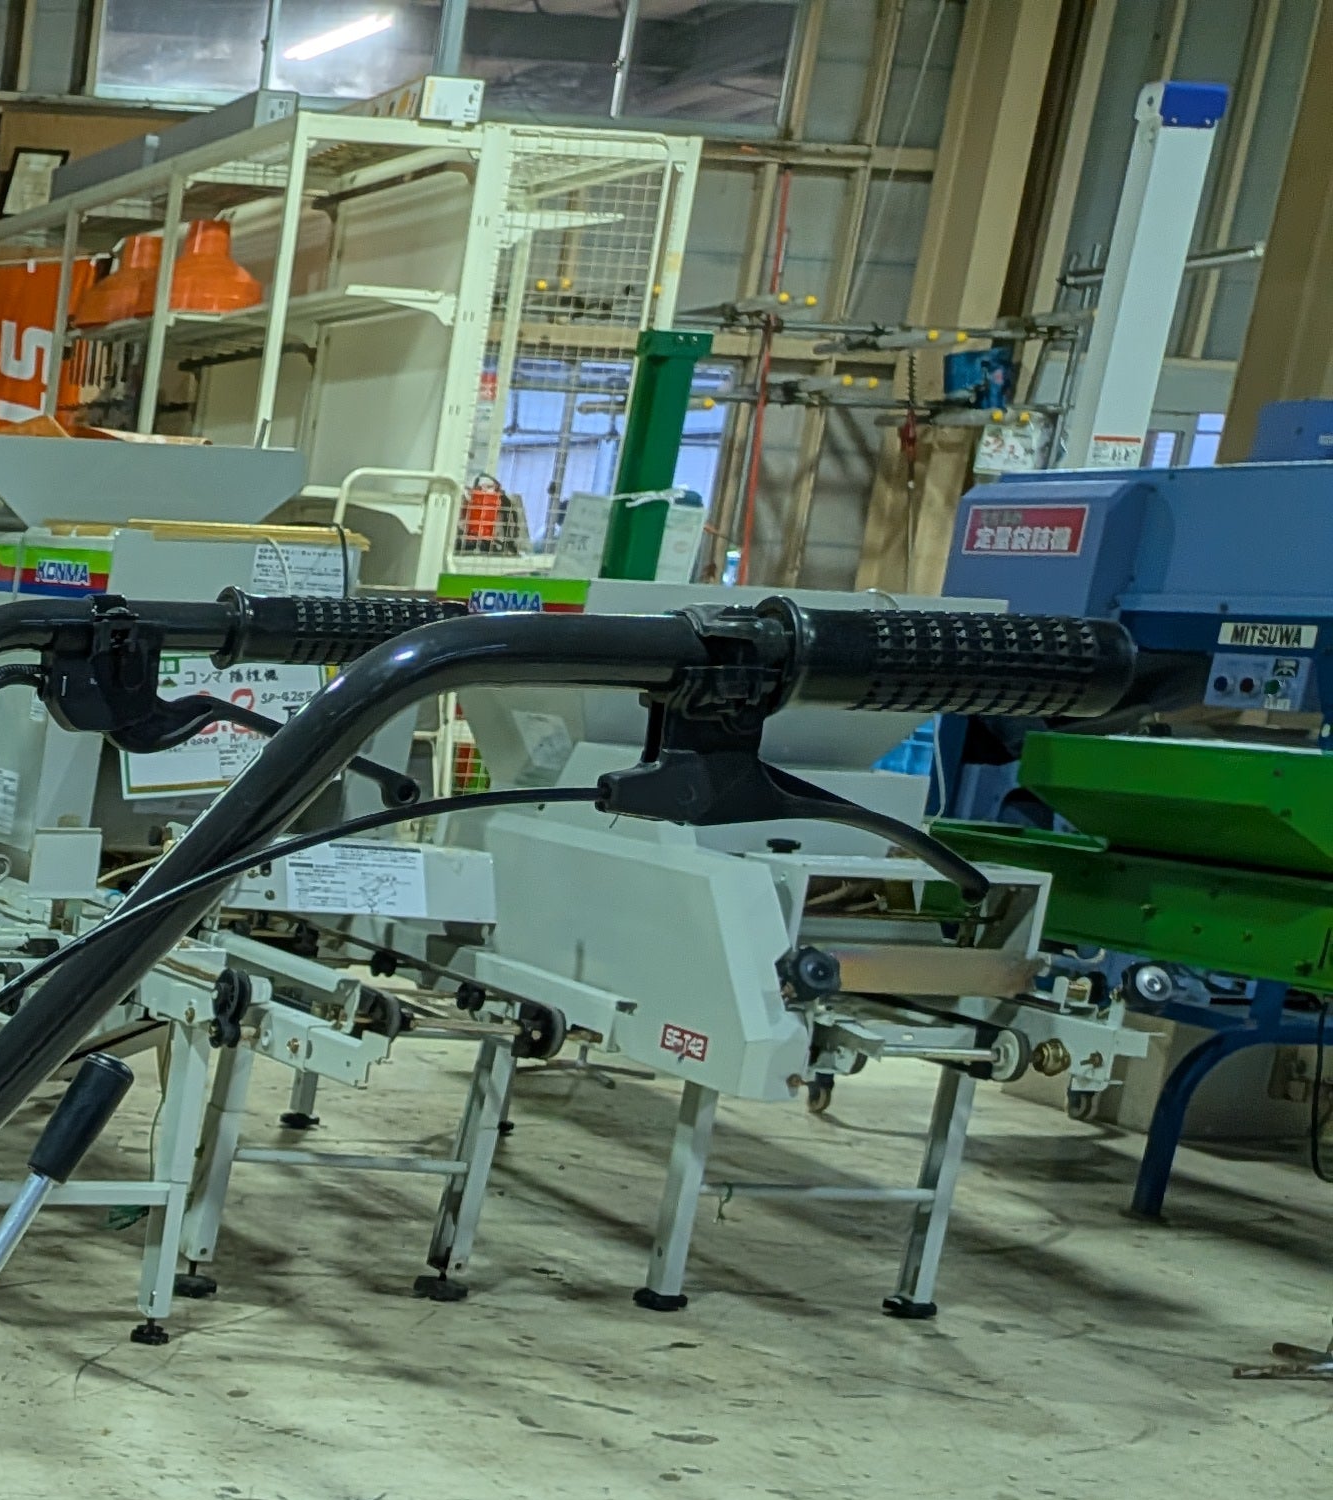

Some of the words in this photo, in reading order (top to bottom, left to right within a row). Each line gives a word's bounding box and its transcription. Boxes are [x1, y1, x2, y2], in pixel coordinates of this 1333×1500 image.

[35, 559, 91, 586] KONMA
[467, 588, 544, 612] KONMA
[1230, 624, 1302, 646] MITSUWA
[184, 670, 223, 685] コンマ
